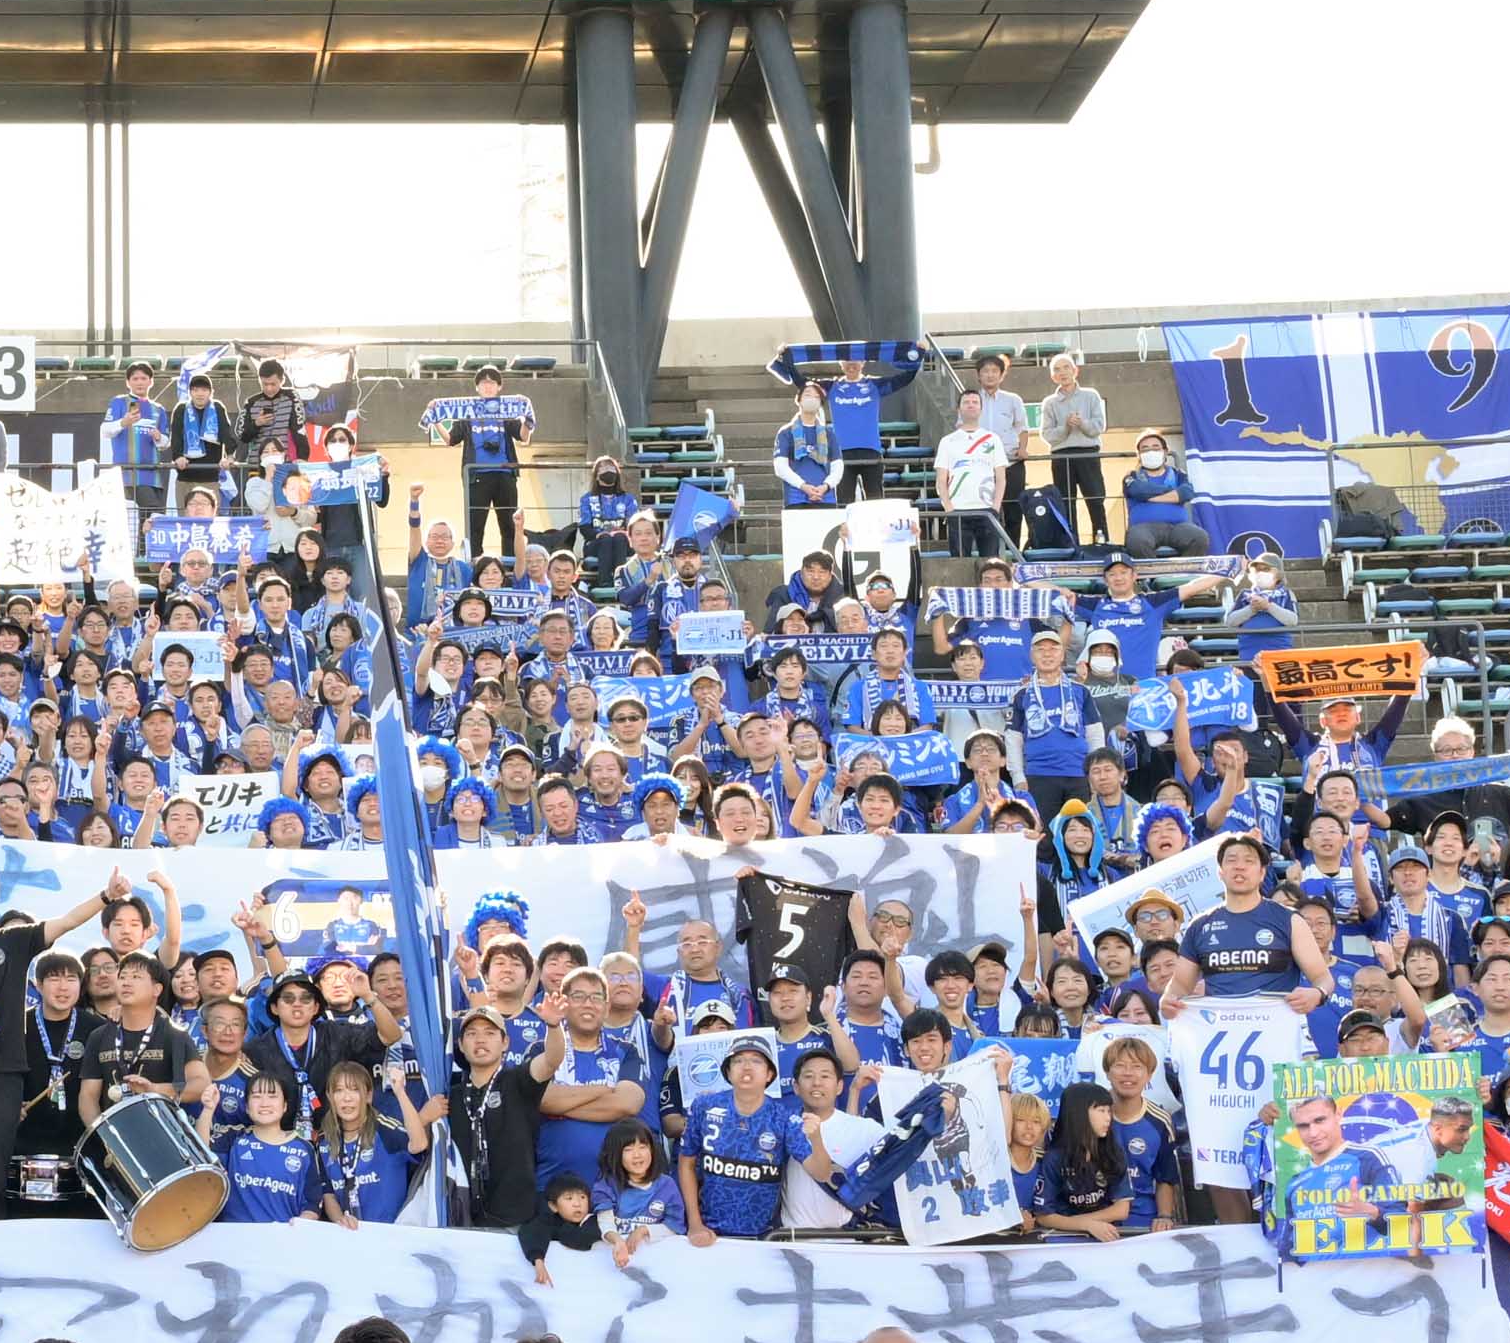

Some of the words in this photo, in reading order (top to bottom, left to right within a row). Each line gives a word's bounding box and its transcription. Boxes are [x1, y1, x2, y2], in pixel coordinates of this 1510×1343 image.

[151, 529, 167, 545] 30
[1231, 702, 1249, 721] 18
[194, 780, 263, 808] エリキ
[772, 904, 812, 960] 5
[1208, 947, 1273, 969] ABEMA
[1219, 1011, 1272, 1024] odakyu
[1199, 1029, 1267, 1092] 46
[1281, 1066, 1318, 1100] ALL
[1324, 1063, 1367, 1096] FOR
[1374, 1058, 1475, 1093] MACHIDA
[1209, 1093, 1258, 1110] HIGUCHI
[702, 1124, 717, 1152] 2
[923, 1195, 942, 1223] 2
[1290, 1210, 1477, 1255] ELIK
